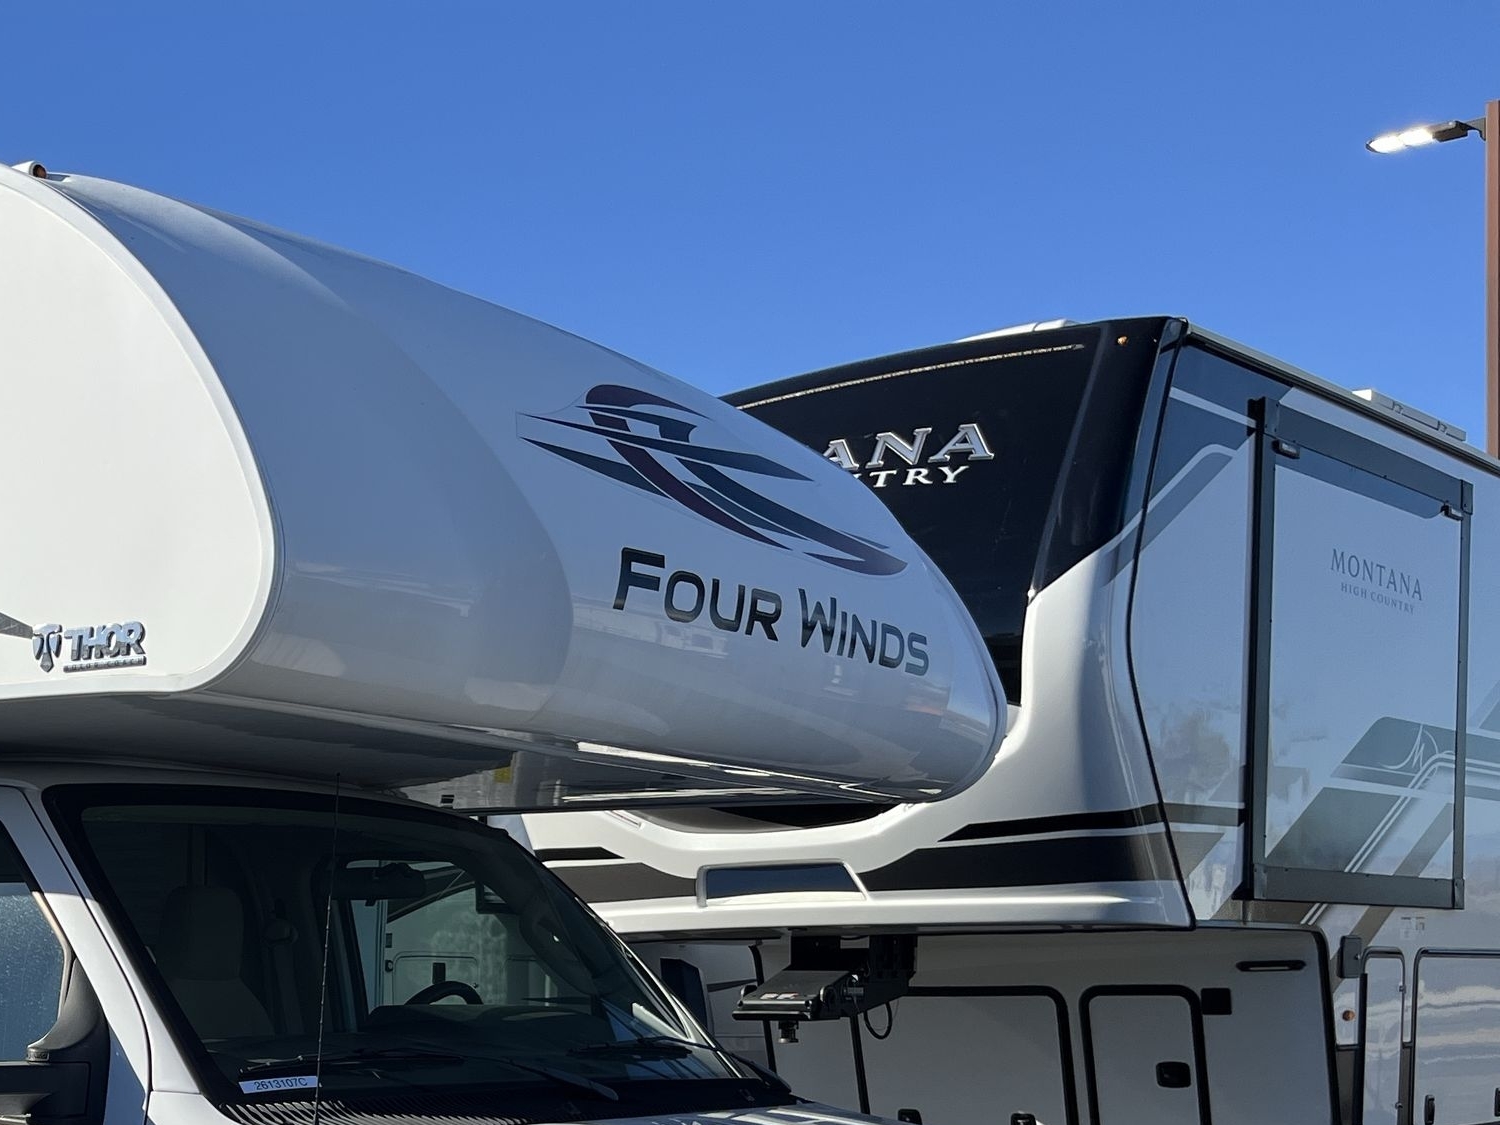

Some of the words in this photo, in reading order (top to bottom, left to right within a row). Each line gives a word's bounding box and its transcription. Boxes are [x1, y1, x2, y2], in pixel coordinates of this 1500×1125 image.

[852, 465, 969, 488] TRY
[1331, 548, 1422, 601] MONTANA
[612, 546, 782, 641] FOUR
[1341, 582, 1367, 599] HIGH
[1370, 592, 1414, 615] COUNTRY
[64, 621, 146, 661] THOR
[254, 1077, 308, 1091] 2613107C
